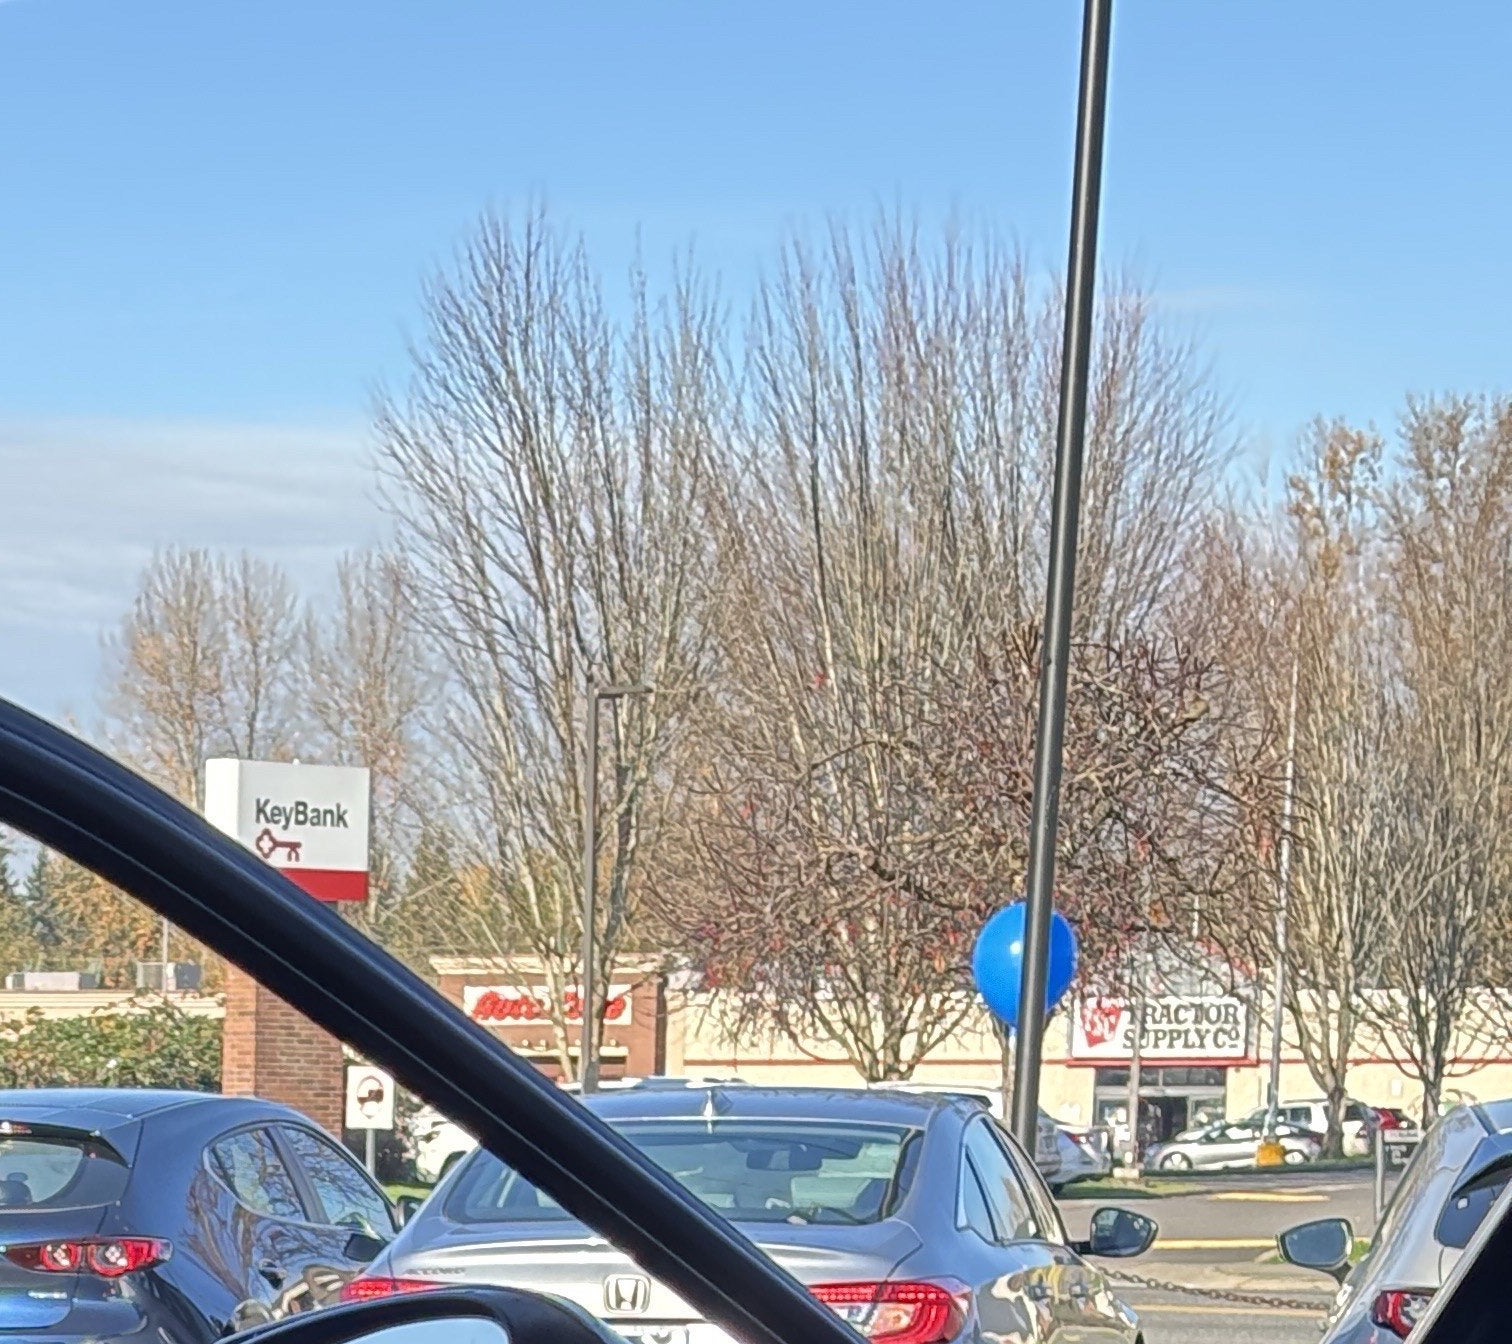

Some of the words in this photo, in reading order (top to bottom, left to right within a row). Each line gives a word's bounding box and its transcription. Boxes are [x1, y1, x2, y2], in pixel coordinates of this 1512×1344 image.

[255, 797, 348, 831] KeyBank
[1122, 1003, 1240, 1025] TRACTOR
[1122, 1027, 1210, 1049] SUPPLY
